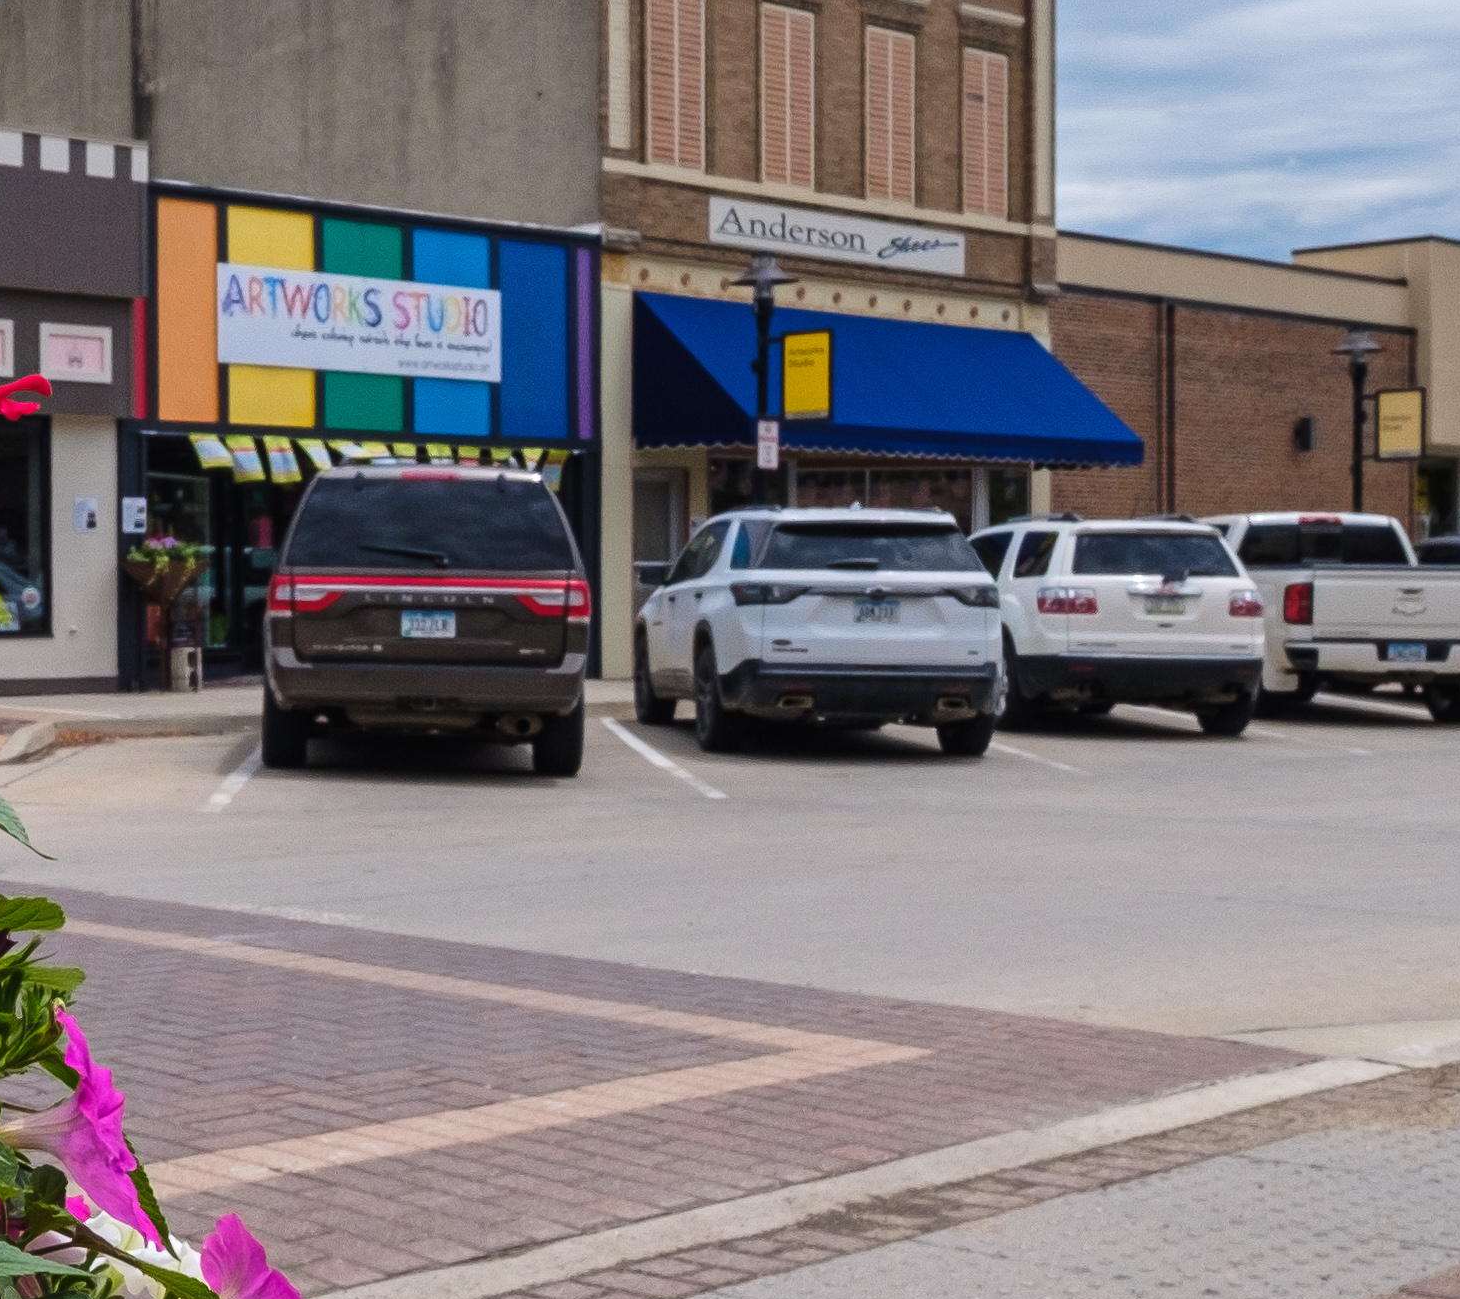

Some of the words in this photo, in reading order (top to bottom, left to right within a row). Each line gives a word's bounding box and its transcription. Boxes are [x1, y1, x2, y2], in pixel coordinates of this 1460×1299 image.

[716, 208, 865, 251] Anderson
[221, 274, 382, 327] ARTWORKS
[392, 290, 489, 337] STUDIO
